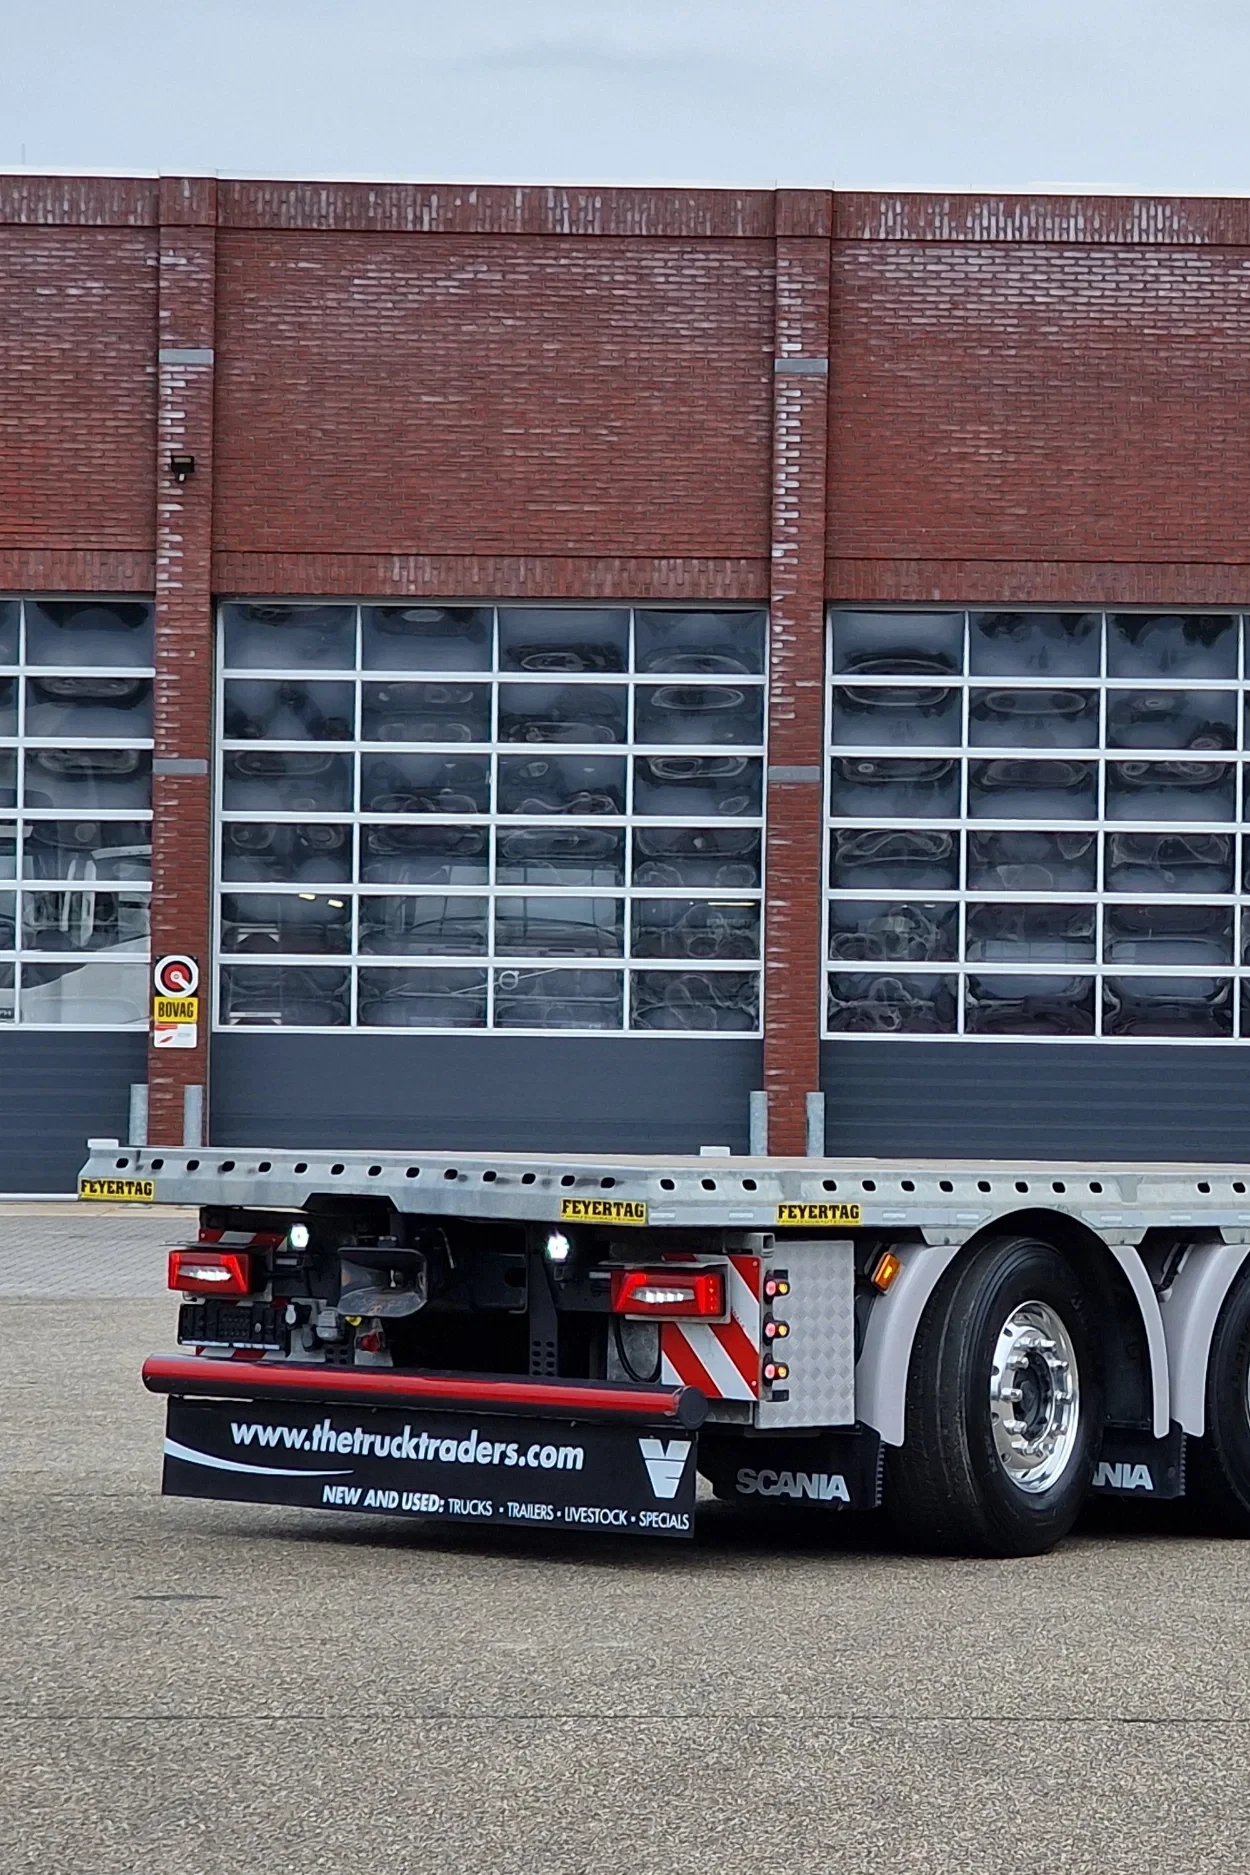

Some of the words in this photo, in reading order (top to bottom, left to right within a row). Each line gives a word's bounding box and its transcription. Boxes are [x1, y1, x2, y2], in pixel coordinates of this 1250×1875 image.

[158, 1001, 194, 1018] BOVAG
[81, 1179, 152, 1196] FEYERTAG
[562, 1199, 644, 1218] FEYERTAG
[778, 1204, 860, 1219] FEYERTAG
[230, 1419, 584, 1470] www.thetrucktraders.com
[736, 1468, 850, 1502] SCANIA
[1092, 1462, 1153, 1490] NIA
[322, 1485, 362, 1504] NEW
[363, 1488, 400, 1508] AND
[401, 1491, 445, 1513] USED:
[448, 1498, 493, 1516] TRUCKS
[507, 1501, 554, 1521] TRAILERS
[564, 1506, 628, 1526] LIVESTOCK
[638, 1510, 690, 1530] SPECIALS
